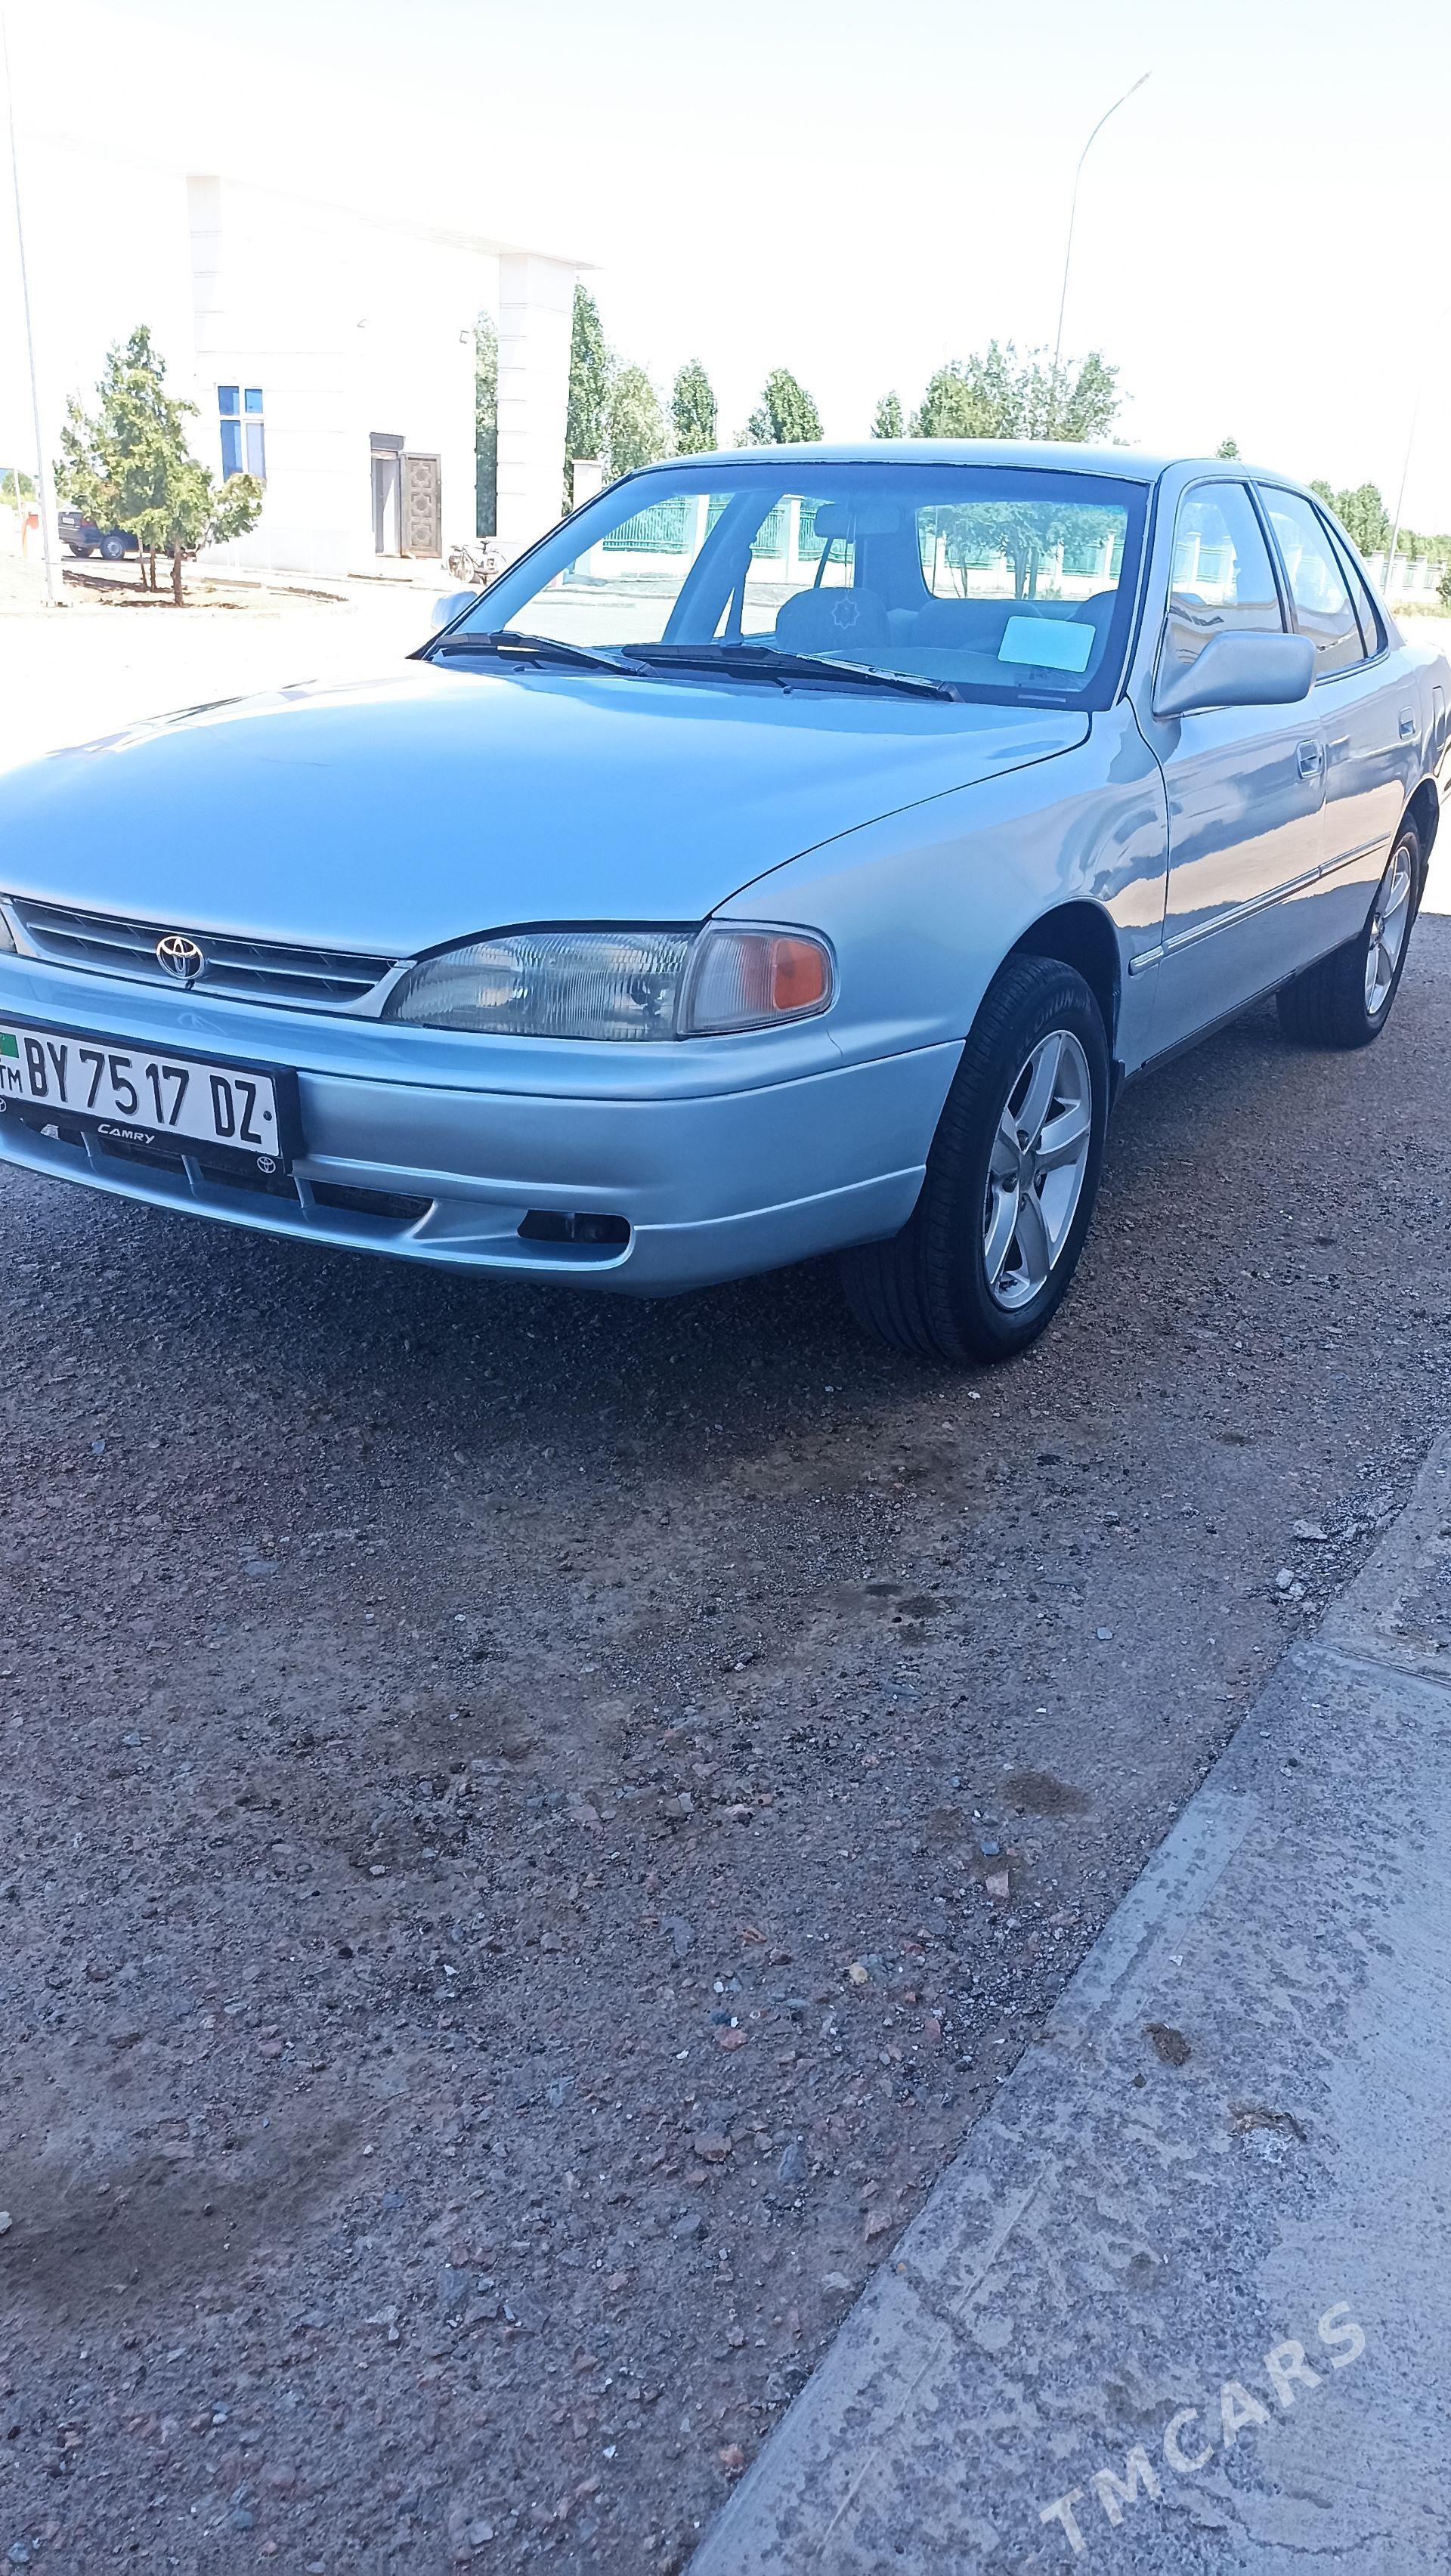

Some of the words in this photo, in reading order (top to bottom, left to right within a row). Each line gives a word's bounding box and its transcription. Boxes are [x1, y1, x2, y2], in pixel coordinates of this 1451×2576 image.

[24, 1038, 67, 1102] BY
[79, 1048, 189, 1126] 7517
[209, 1075, 262, 1144] DZ
